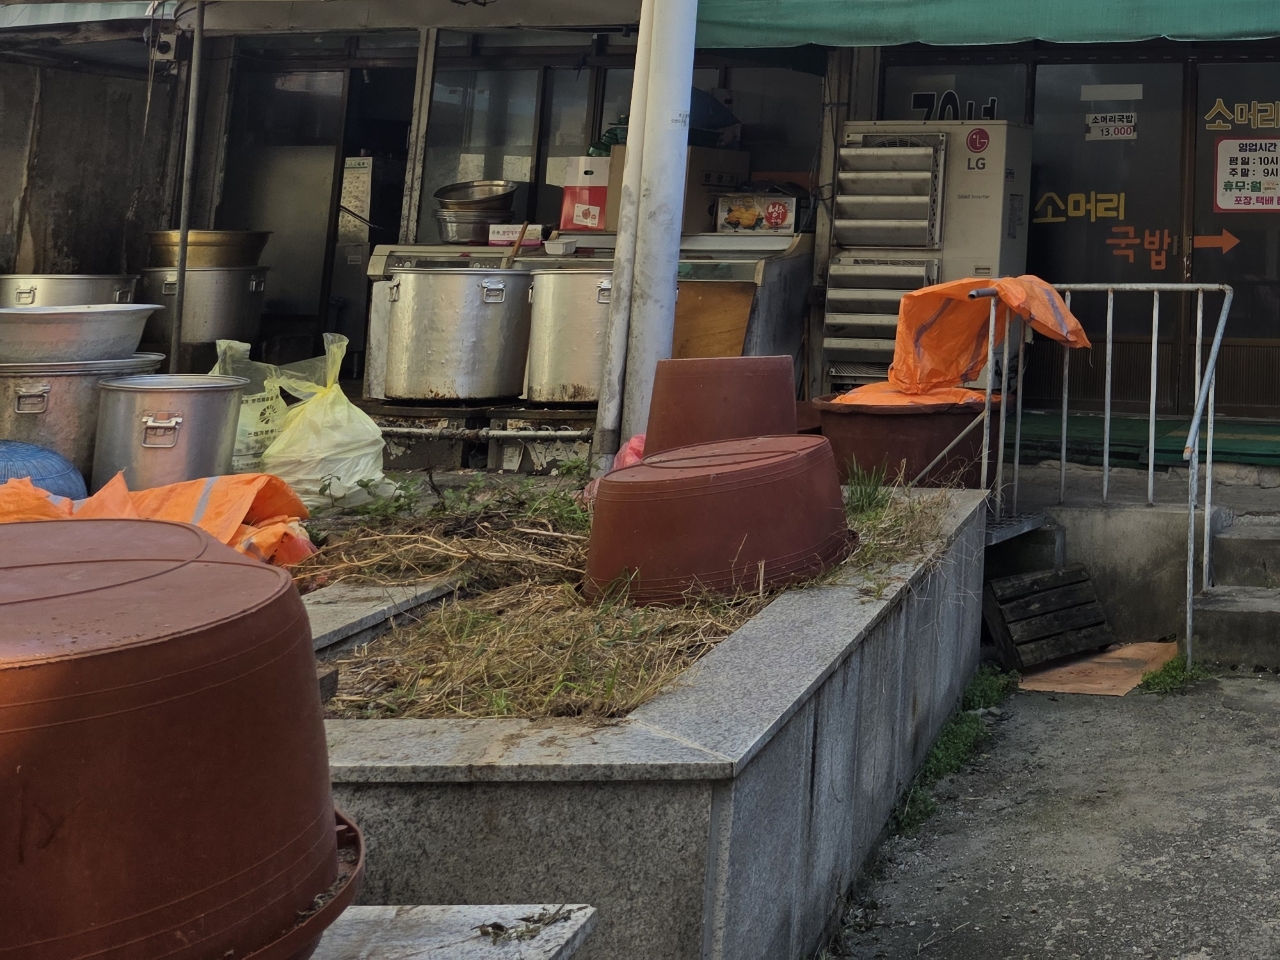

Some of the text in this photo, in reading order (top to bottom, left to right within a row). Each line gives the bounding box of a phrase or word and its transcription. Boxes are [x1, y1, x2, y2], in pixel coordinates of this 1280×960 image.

[1091, 114, 1134, 124] 소머리국밥
[1238, 143, 1277, 152] 영업시간
[967, 157, 986, 170] LG
[1258, 156, 1279, 166] 10시
[1263, 168, 1279, 177] 9시
[1033, 191, 1126, 224] 소머리
[1105, 226, 1172, 270] 국밥
